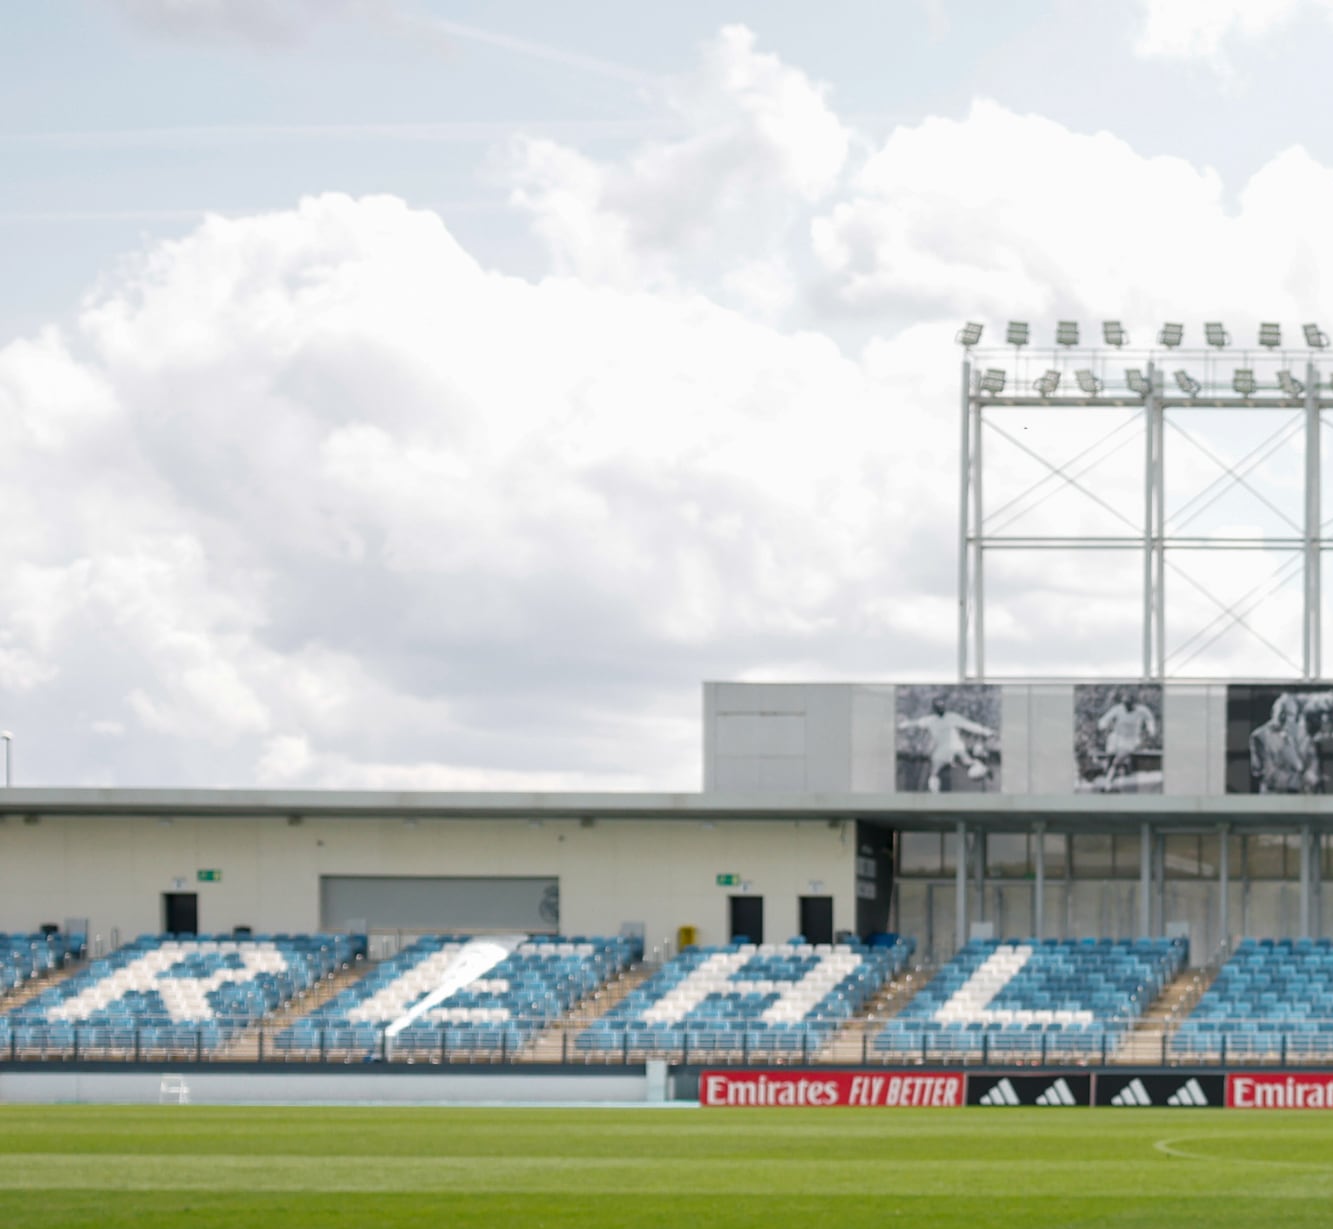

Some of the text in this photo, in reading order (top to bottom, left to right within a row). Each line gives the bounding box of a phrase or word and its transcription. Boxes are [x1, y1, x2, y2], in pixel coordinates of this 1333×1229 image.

[706, 1075, 959, 1106] Emirates FLY BETTER
